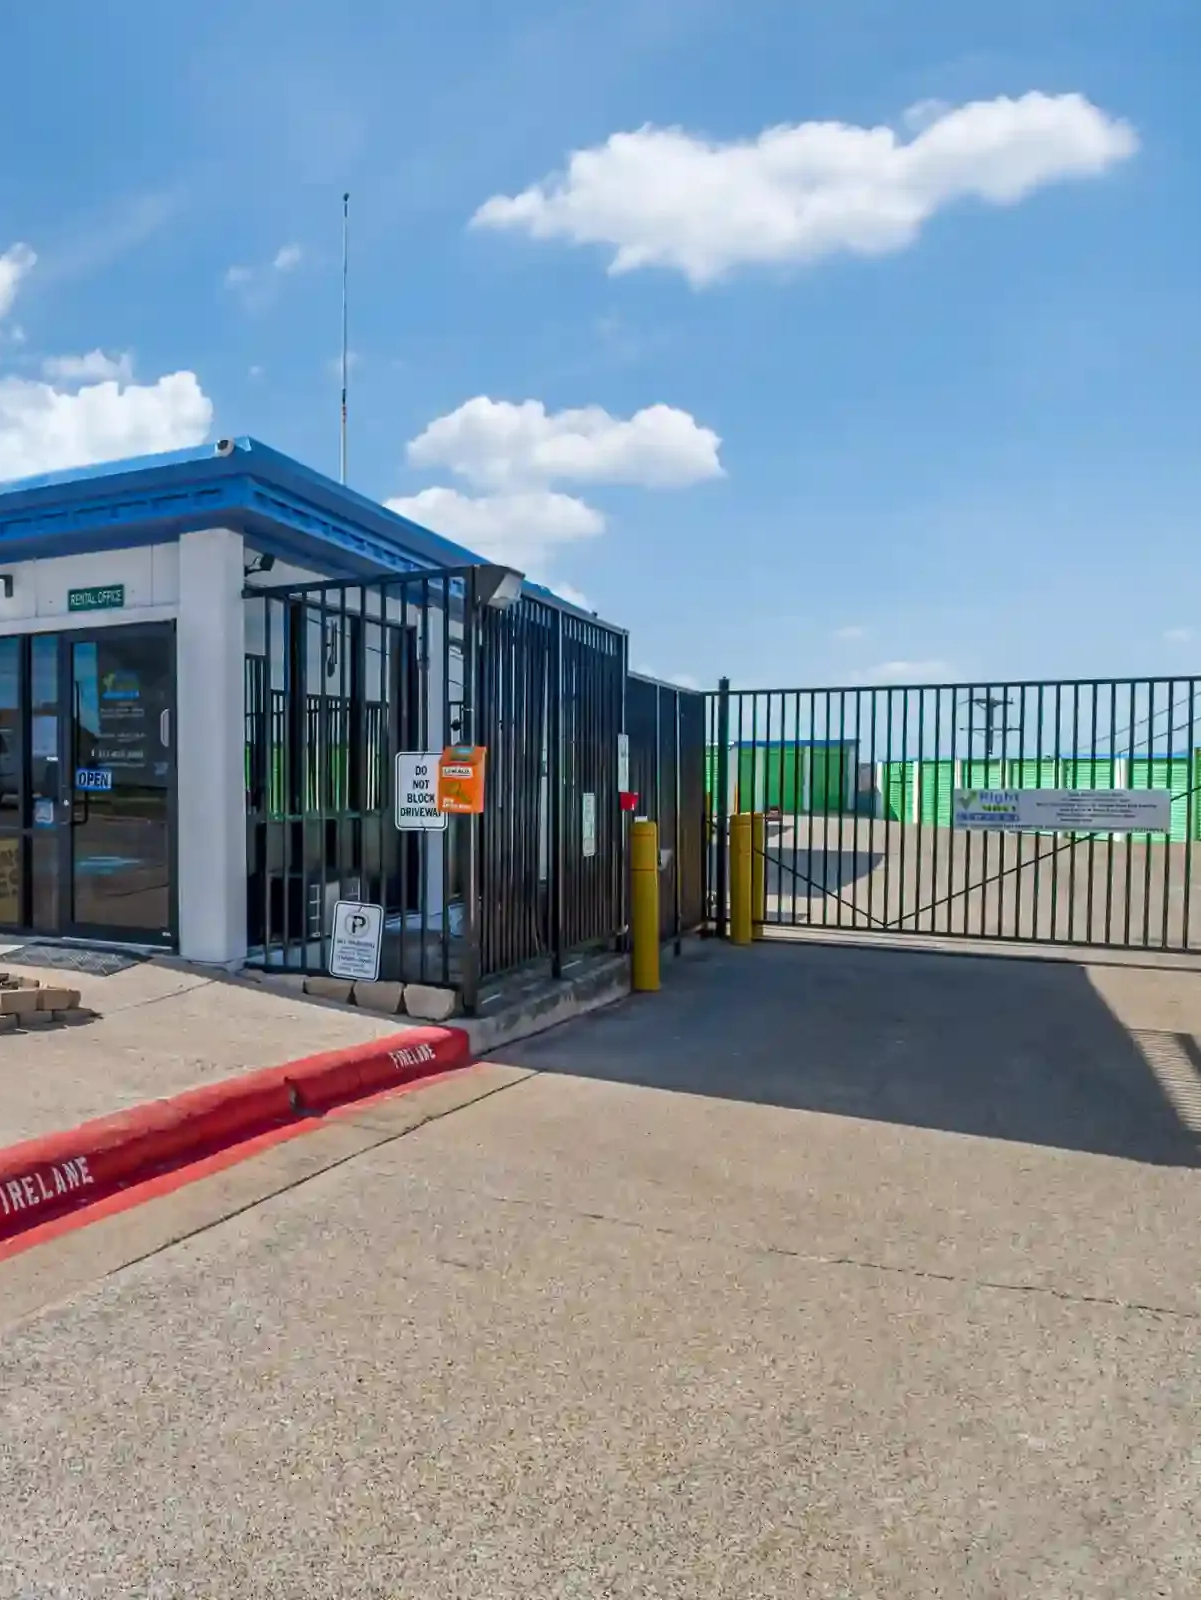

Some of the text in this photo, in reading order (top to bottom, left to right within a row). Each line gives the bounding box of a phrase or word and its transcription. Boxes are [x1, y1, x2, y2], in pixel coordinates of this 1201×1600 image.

[70, 589, 122, 605] RENTAL OFFICE
[415, 765, 428, 776] DO
[78, 771, 111, 788] OPEN
[412, 780, 430, 790] NOT
[406, 793, 435, 804] BLOCK
